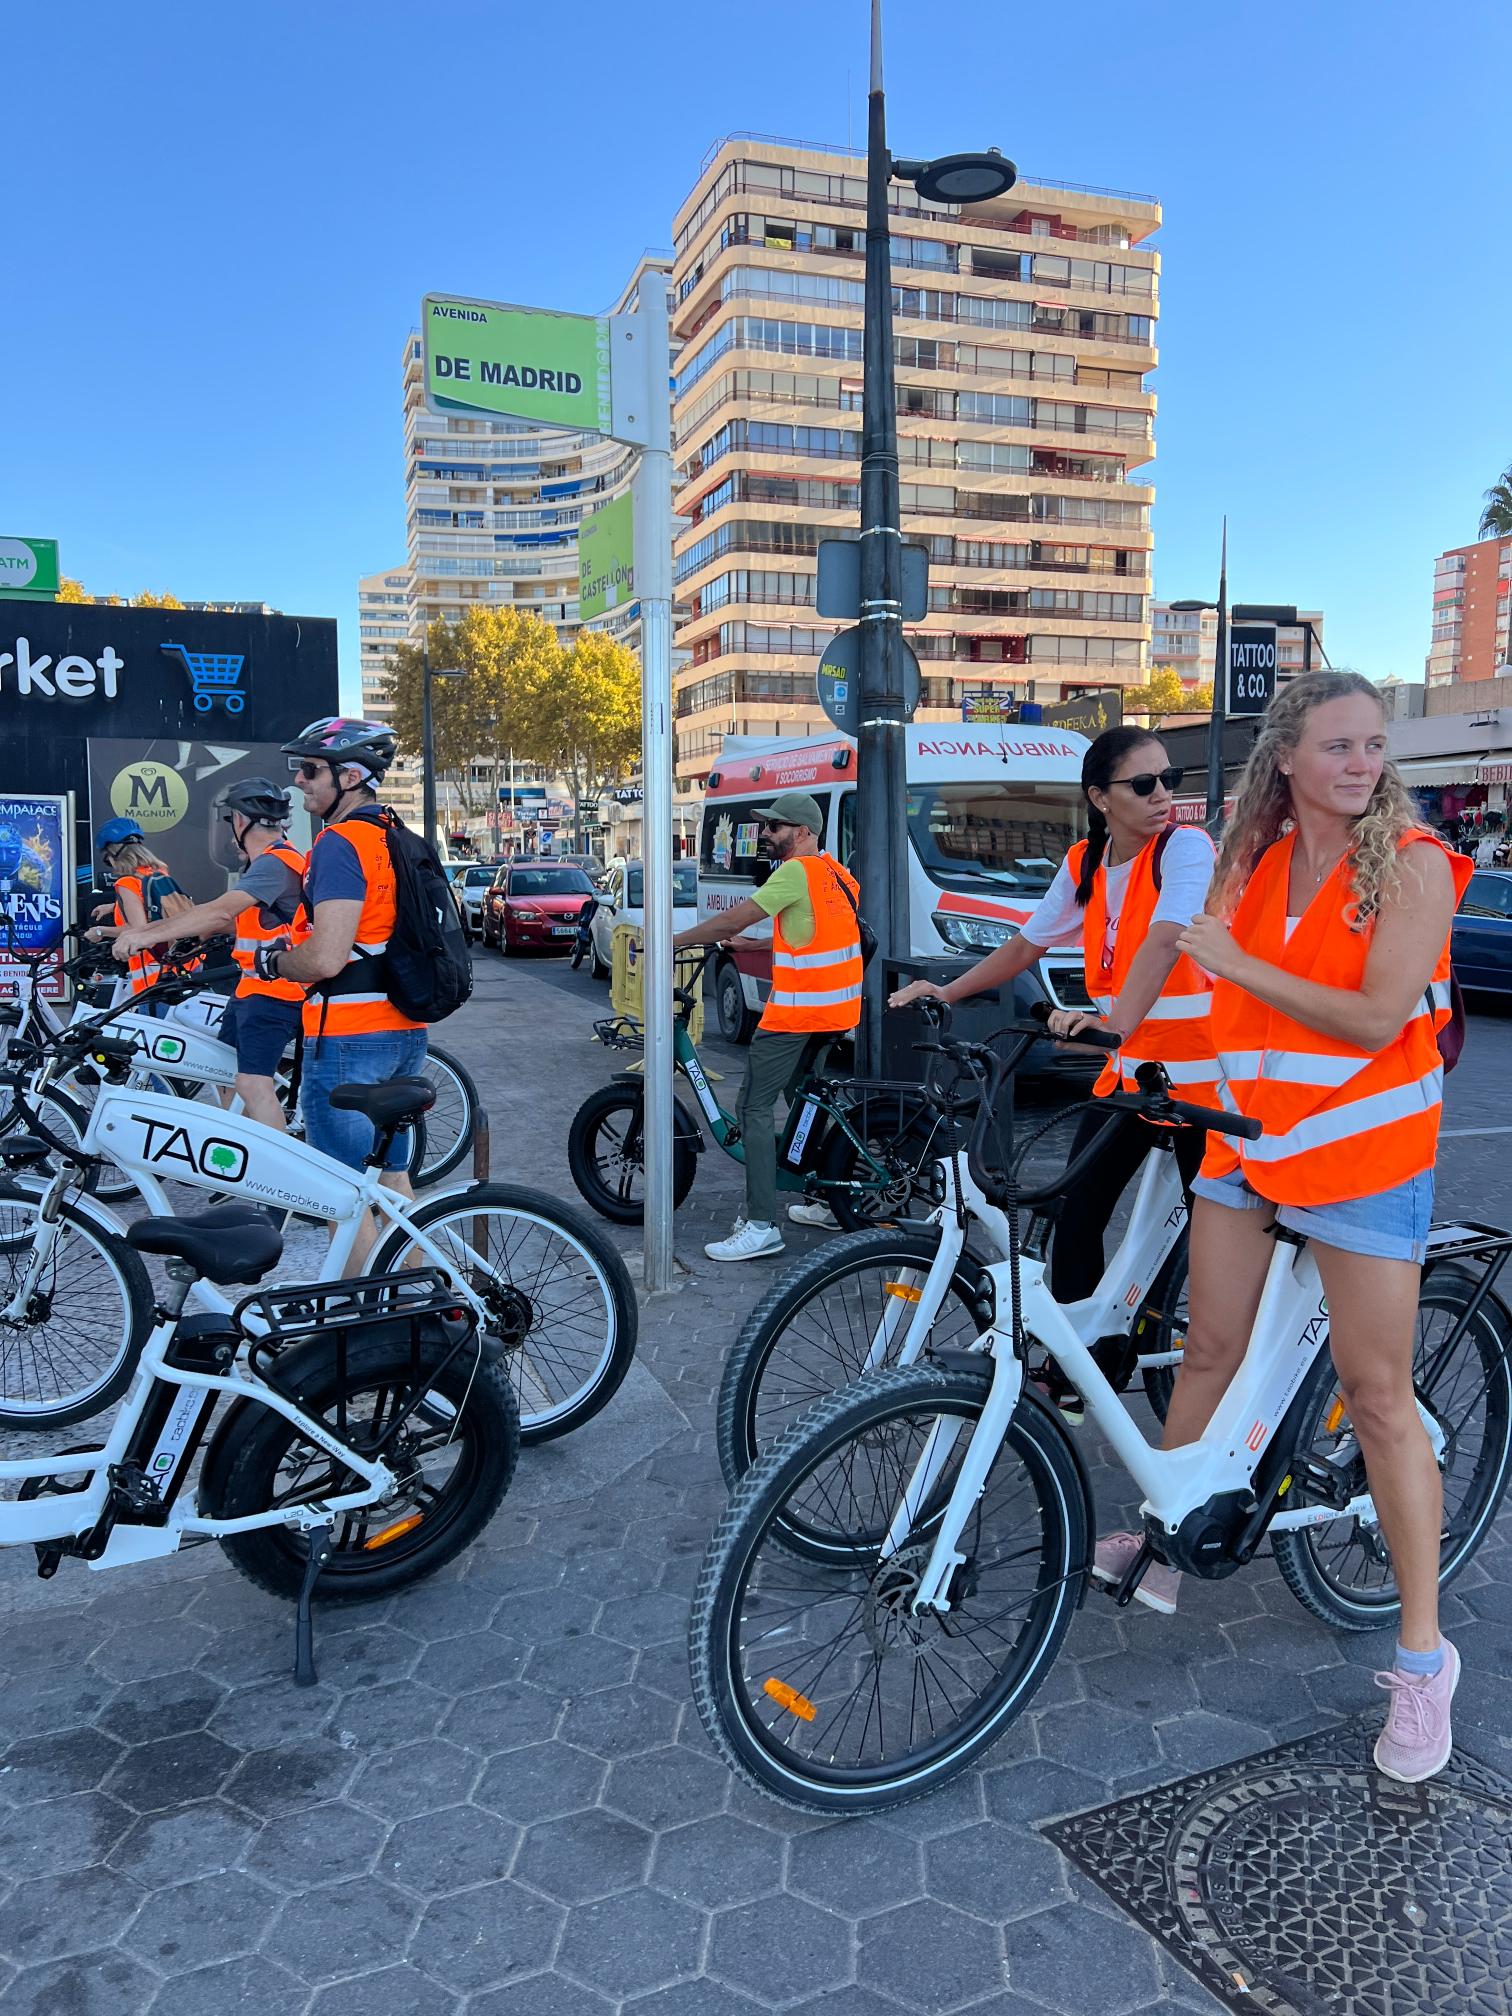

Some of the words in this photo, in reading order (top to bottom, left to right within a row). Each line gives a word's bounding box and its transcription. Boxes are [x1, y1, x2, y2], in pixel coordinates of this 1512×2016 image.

[432, 305, 488, 324] AVENIDA
[435, 354, 471, 381] DE
[480, 361, 582, 395] MADRID
[581, 560, 592, 579] DE
[1231, 643, 1275, 668] TATTOO
[1237, 676, 1247, 697] &
[1247, 676, 1268, 698] CO.
[799, 748, 834, 766] SALVAMENT
[775, 771, 781, 785] Y
[1482, 765, 1512, 782] BEBI
[125, 808, 177, 818] MAGNUM
[1175, 805, 1194, 821] TATTOO
[103, 1022, 187, 1063] TAO
[688, 1060, 707, 1091] TAO
[131, 1113, 249, 1183] TAO
[790, 1131, 806, 1155] TAO
[293, 1415, 315, 1436] Explore
[319, 1435, 332, 1448] New
